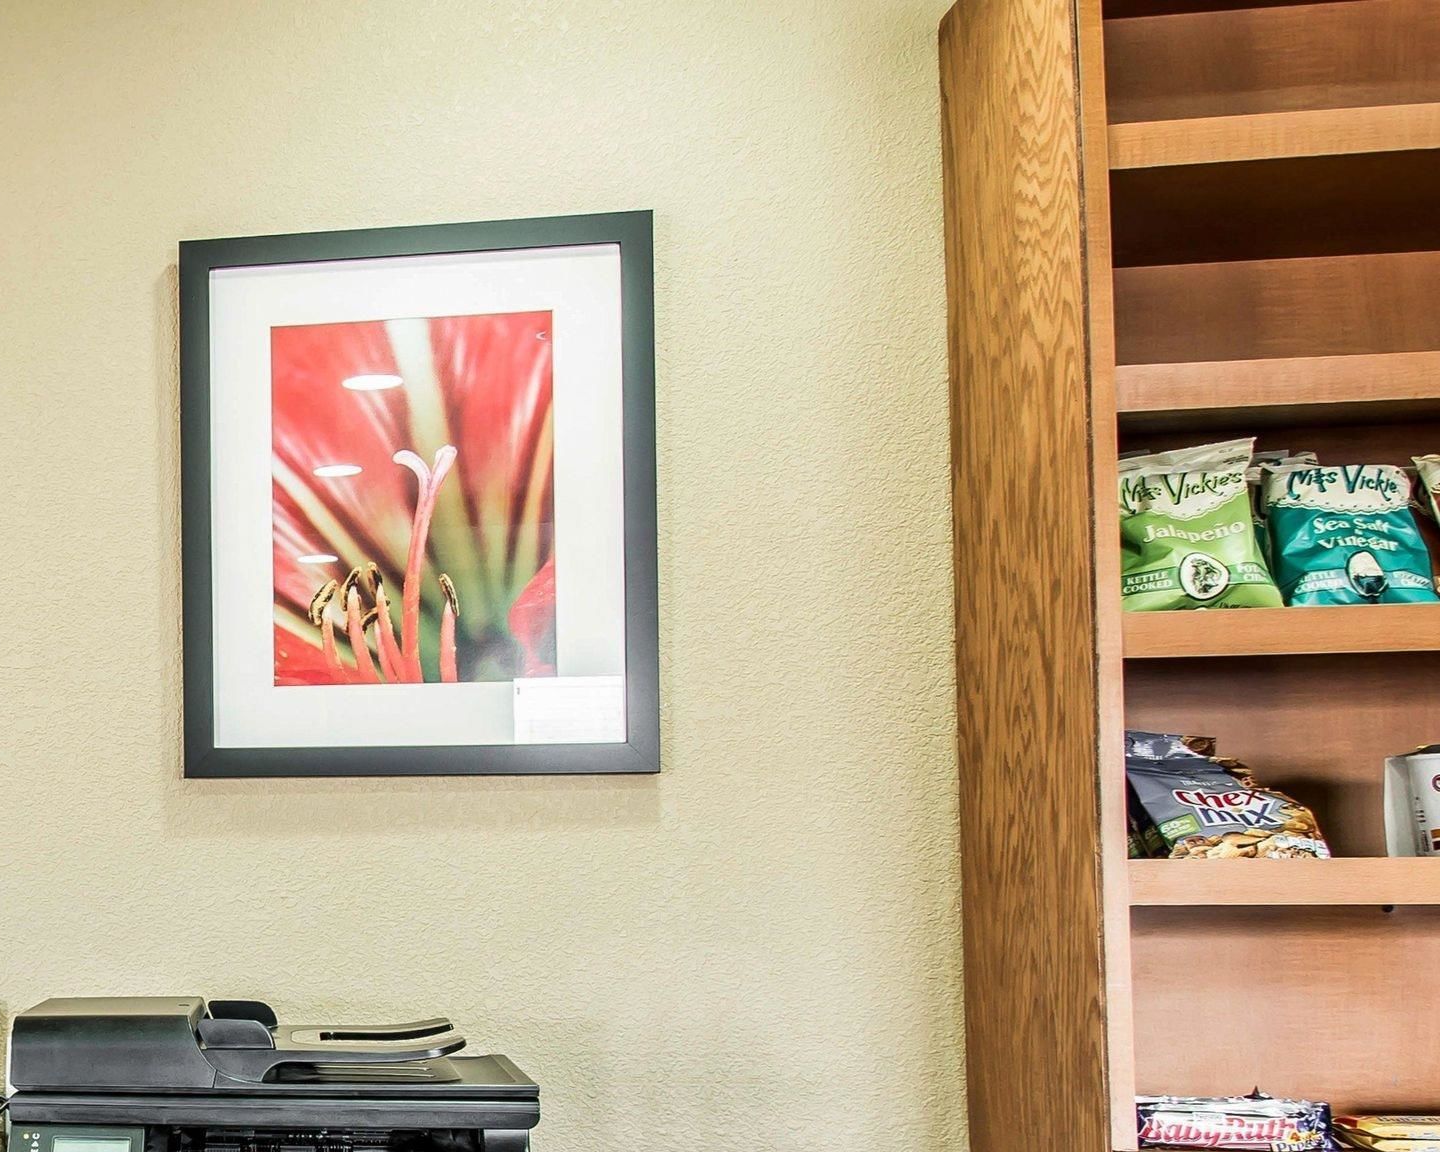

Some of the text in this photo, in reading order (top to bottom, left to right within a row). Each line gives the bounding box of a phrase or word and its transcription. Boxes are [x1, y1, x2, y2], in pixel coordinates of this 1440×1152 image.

[1143, 521, 1246, 543] Jalapeño
[1313, 517, 1390, 534] Sea Salt
[1318, 535, 1399, 551] Vinegar
[1127, 570, 1169, 585] KETTLE
[1123, 579, 1173, 595] COOKED
